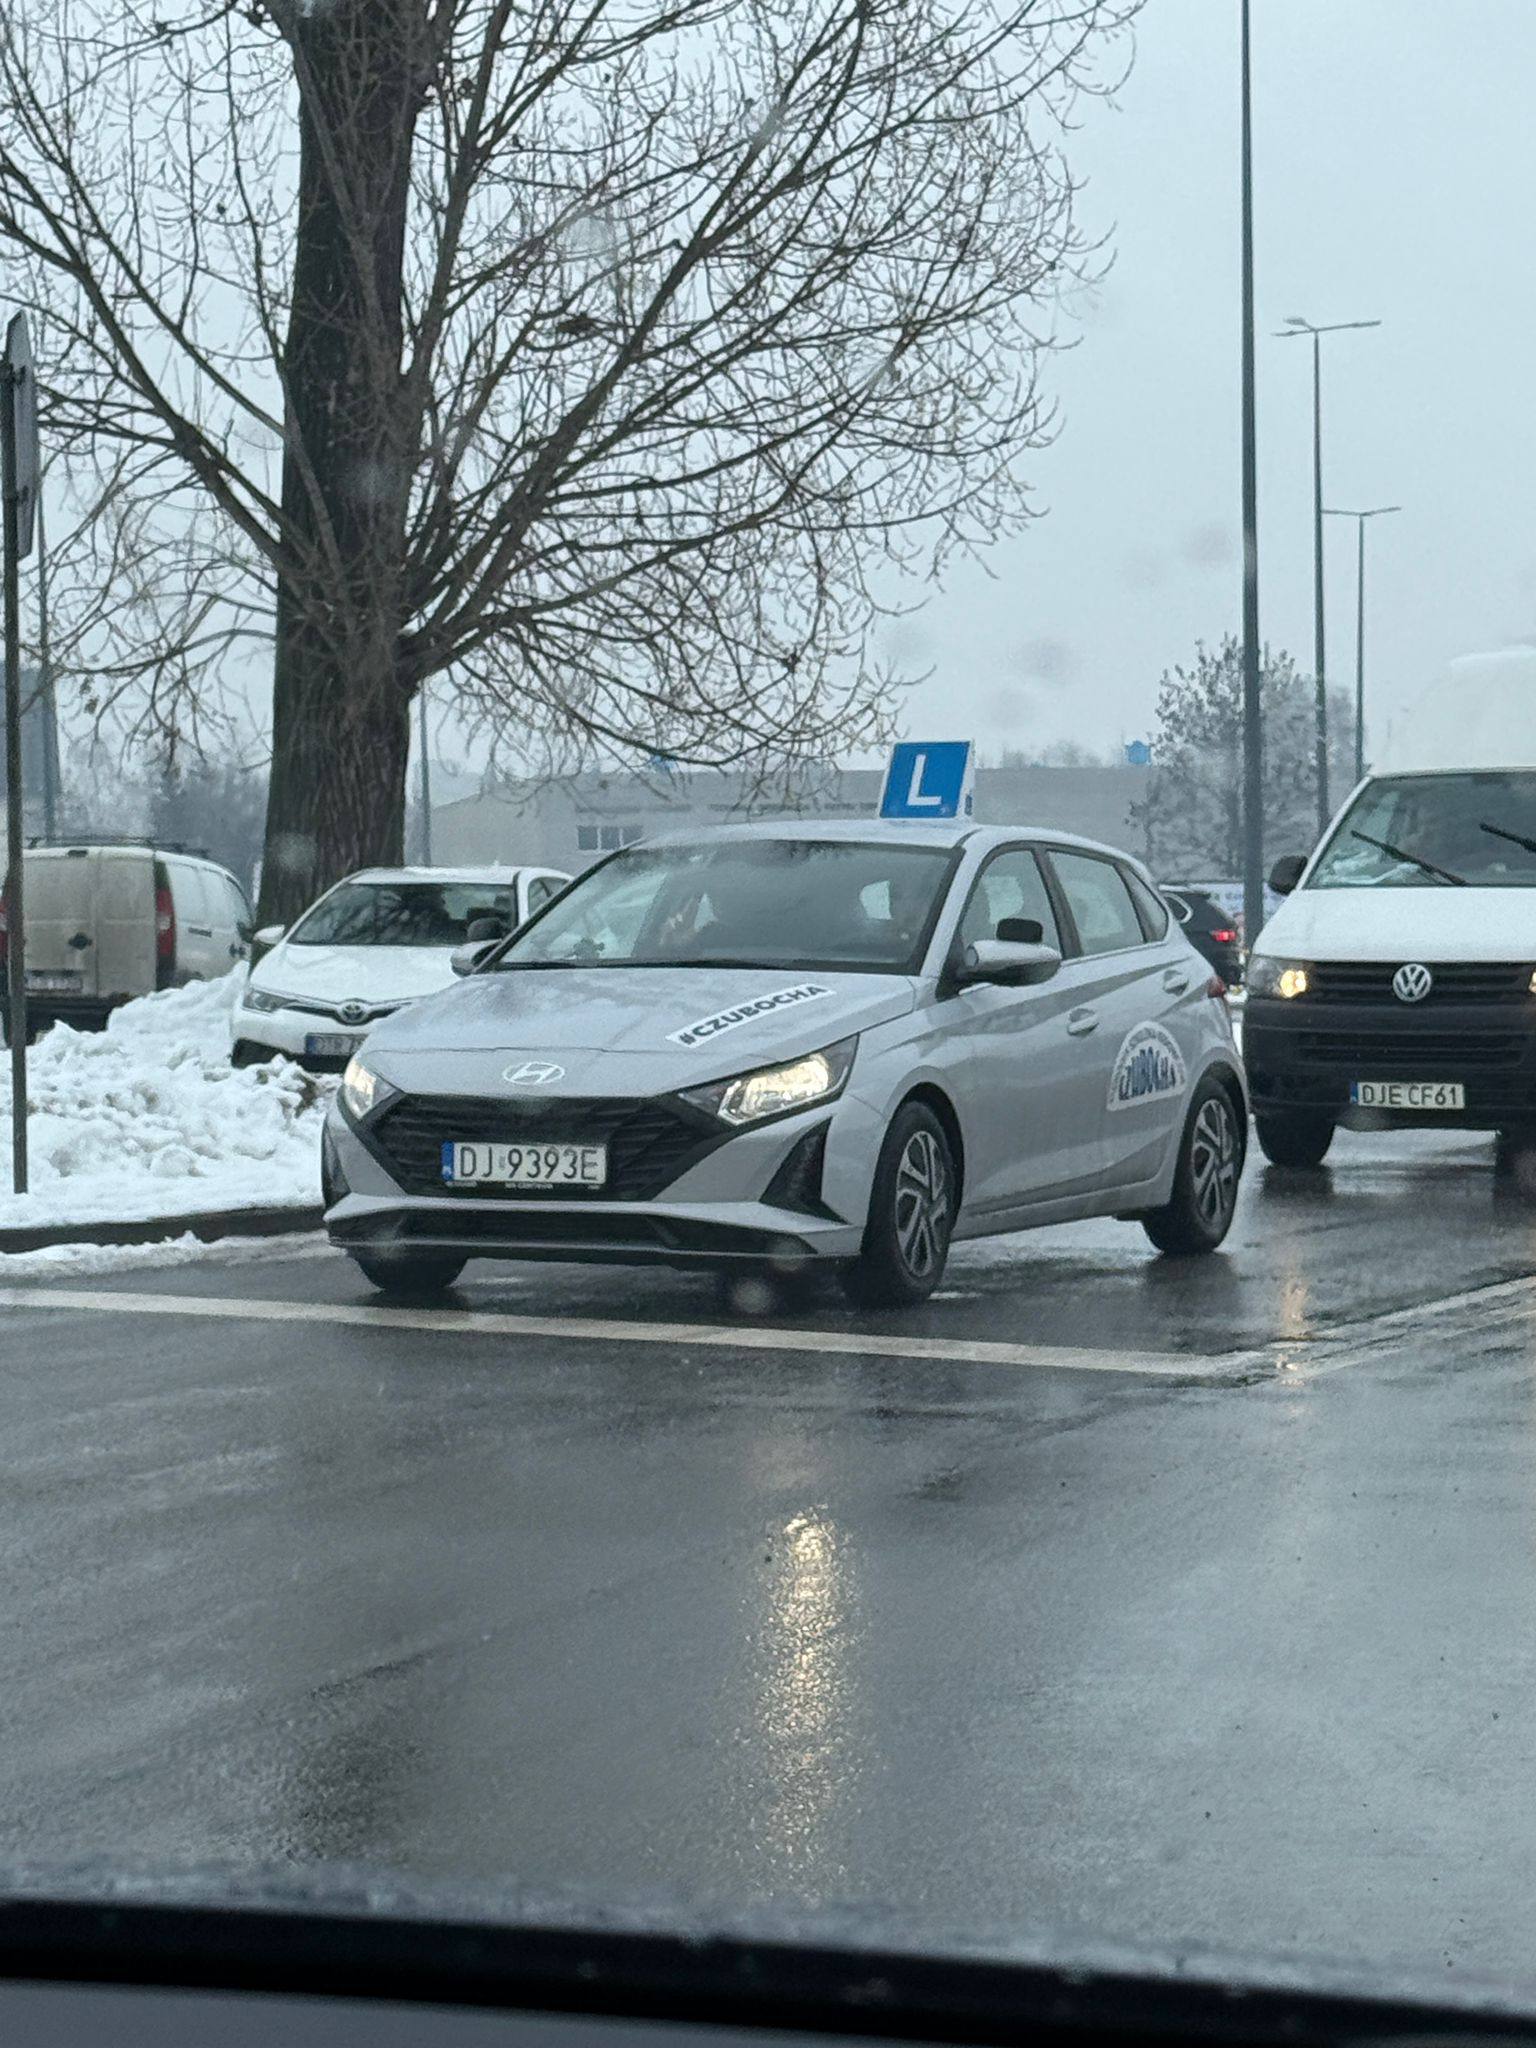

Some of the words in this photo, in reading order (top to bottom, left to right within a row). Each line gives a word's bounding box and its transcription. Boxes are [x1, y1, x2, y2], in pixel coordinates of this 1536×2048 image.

[907, 754, 942, 806] L
[679, 985, 827, 1044] #CZUBOCHA
[1362, 1085, 1402, 1105] DJE
[1408, 1086, 1457, 1105] CF61
[460, 1146, 493, 1178] DJ
[507, 1147, 598, 1181] 9393E
